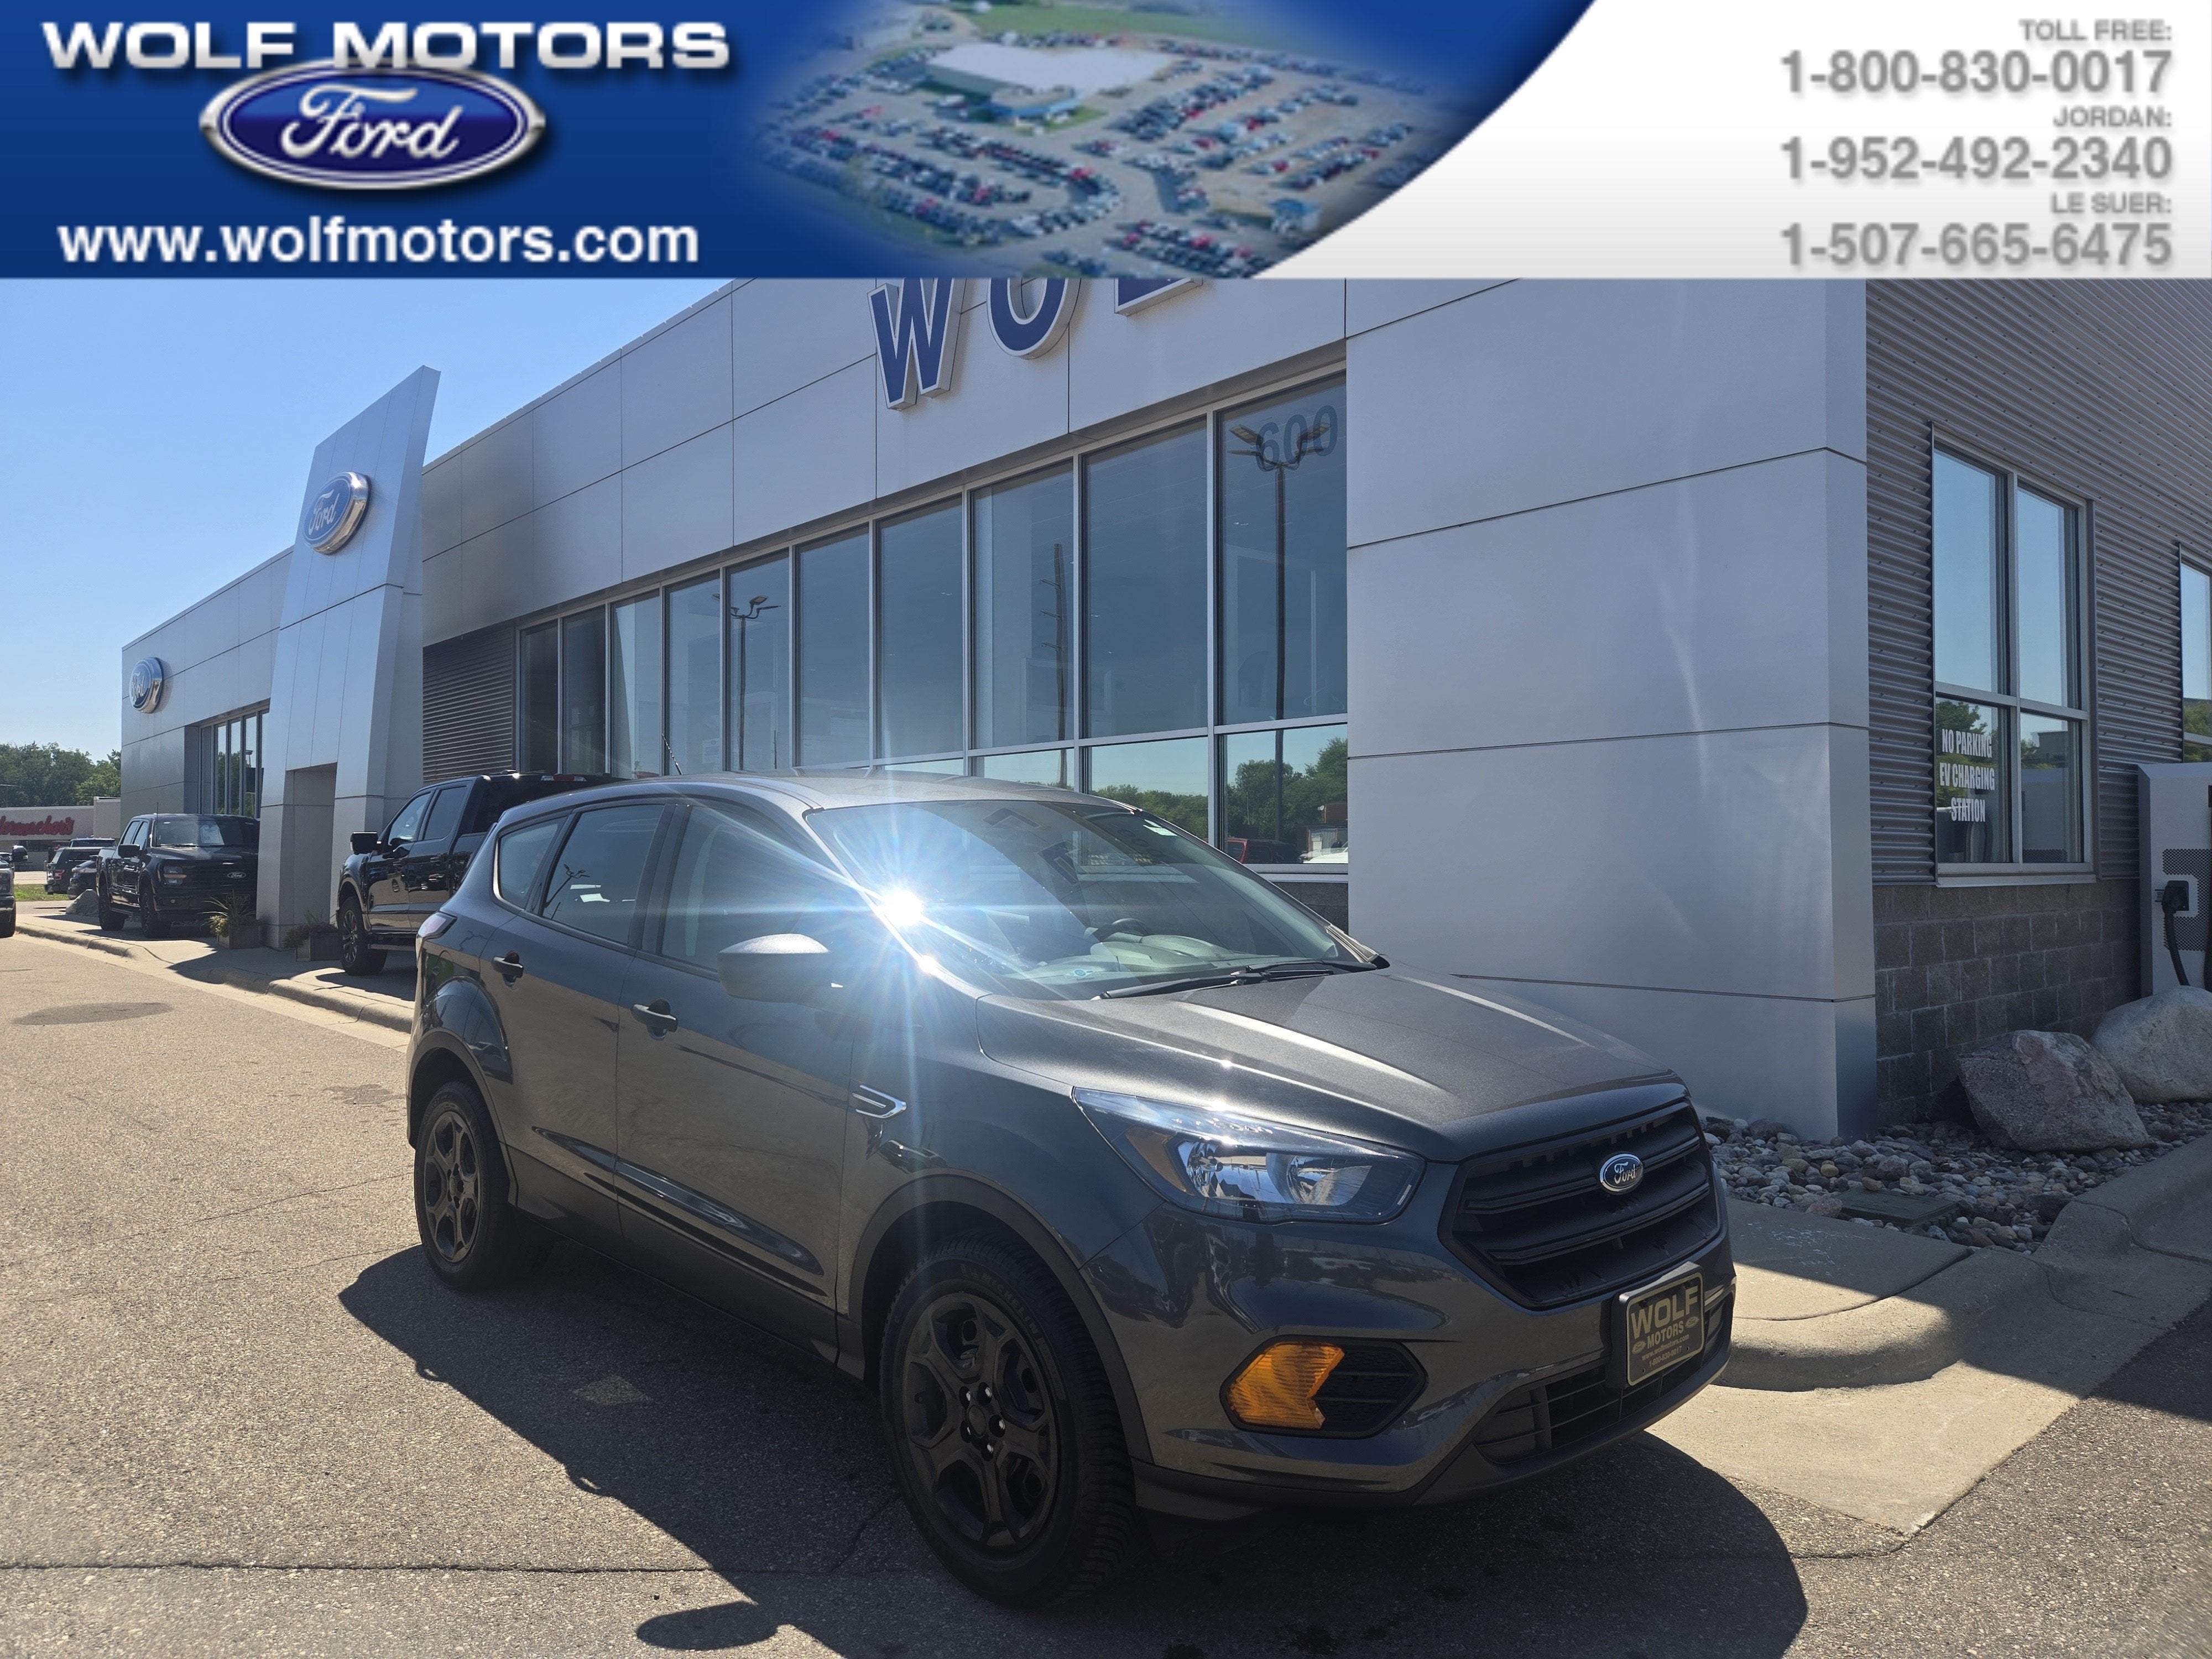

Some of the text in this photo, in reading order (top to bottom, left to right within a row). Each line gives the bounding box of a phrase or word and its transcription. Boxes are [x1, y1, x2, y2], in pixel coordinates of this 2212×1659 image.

[1255, 405, 1338, 472] 600
[309, 489, 340, 535] Ford
[1942, 728, 1992, 758] NO PARKING
[1939, 762, 1995, 790] EV CHARGING
[1951, 797, 1985, 822] STATION
[1614, 1161, 1636, 1184] Ford
[1631, 1285, 1698, 1339] WOLF
[1647, 1321, 1684, 1349] MOTORS
